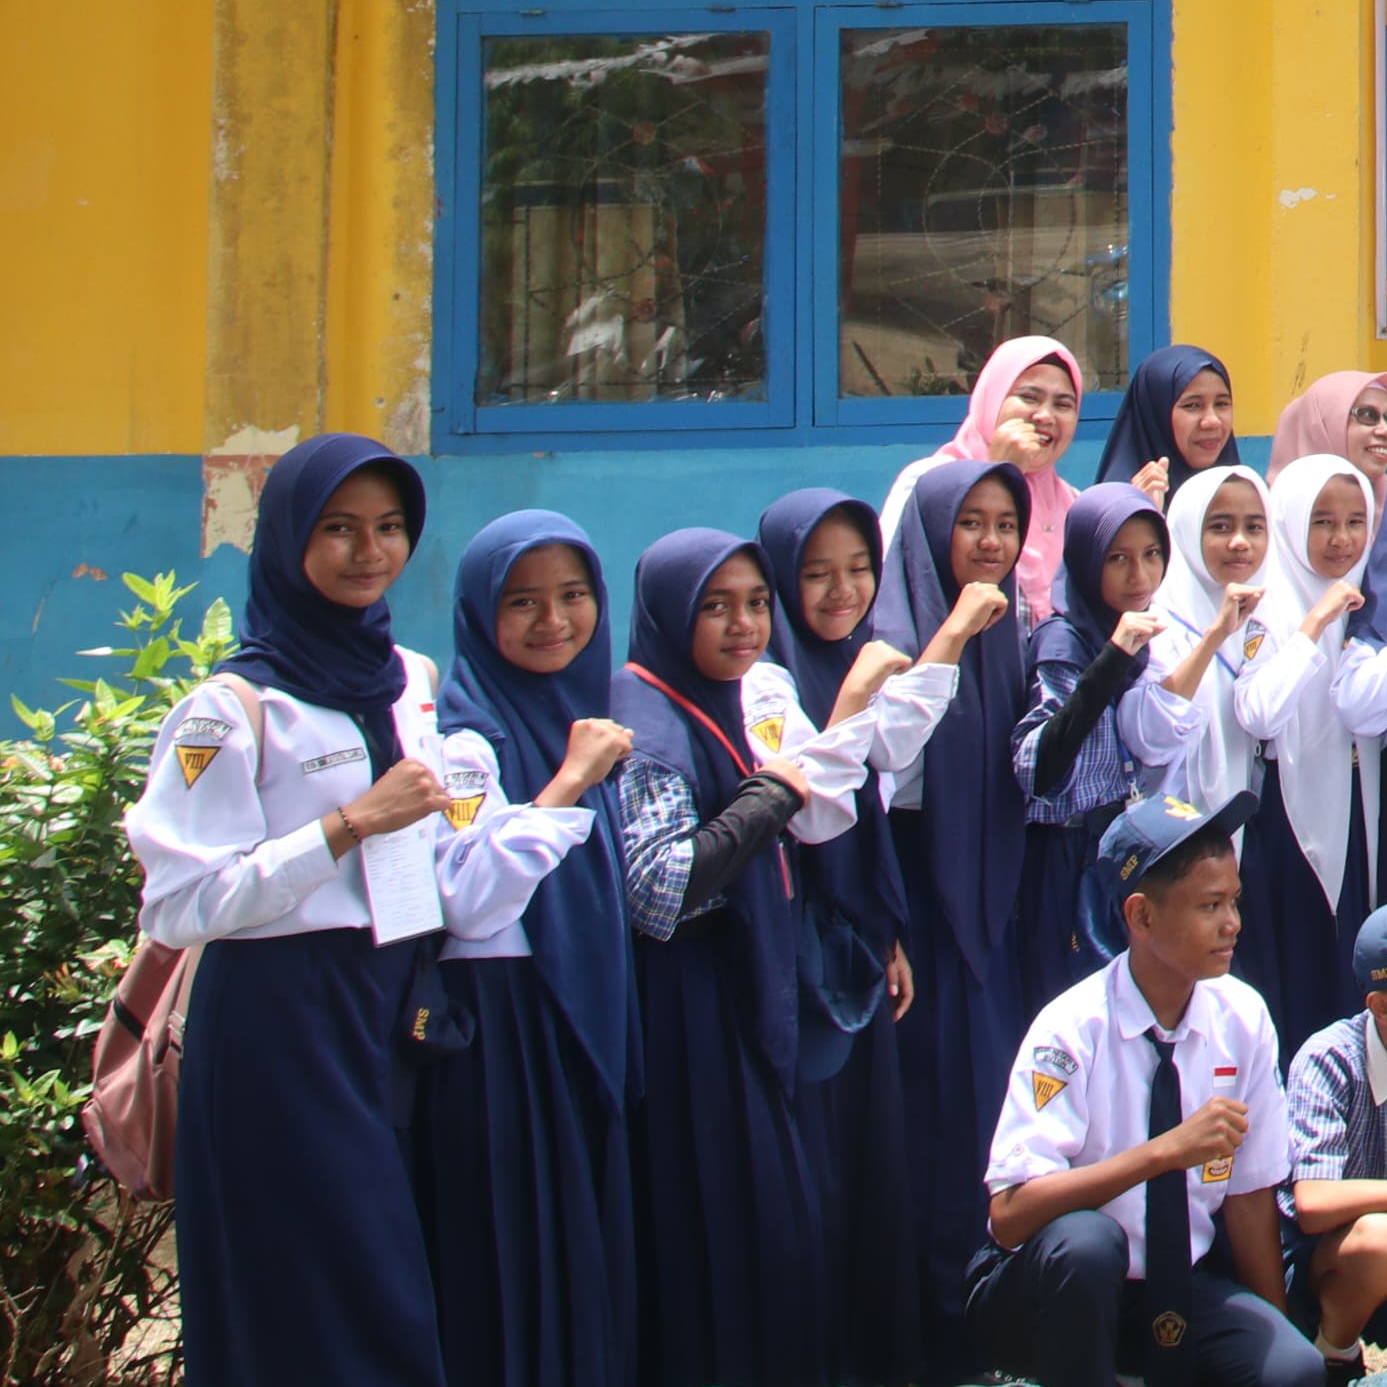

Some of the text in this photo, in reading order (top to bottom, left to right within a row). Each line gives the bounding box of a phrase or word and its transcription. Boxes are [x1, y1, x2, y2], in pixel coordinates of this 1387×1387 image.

[179, 752, 207, 770] VIII
[1119, 854, 1139, 881] SMP
[413, 1007, 430, 1041] SMP
